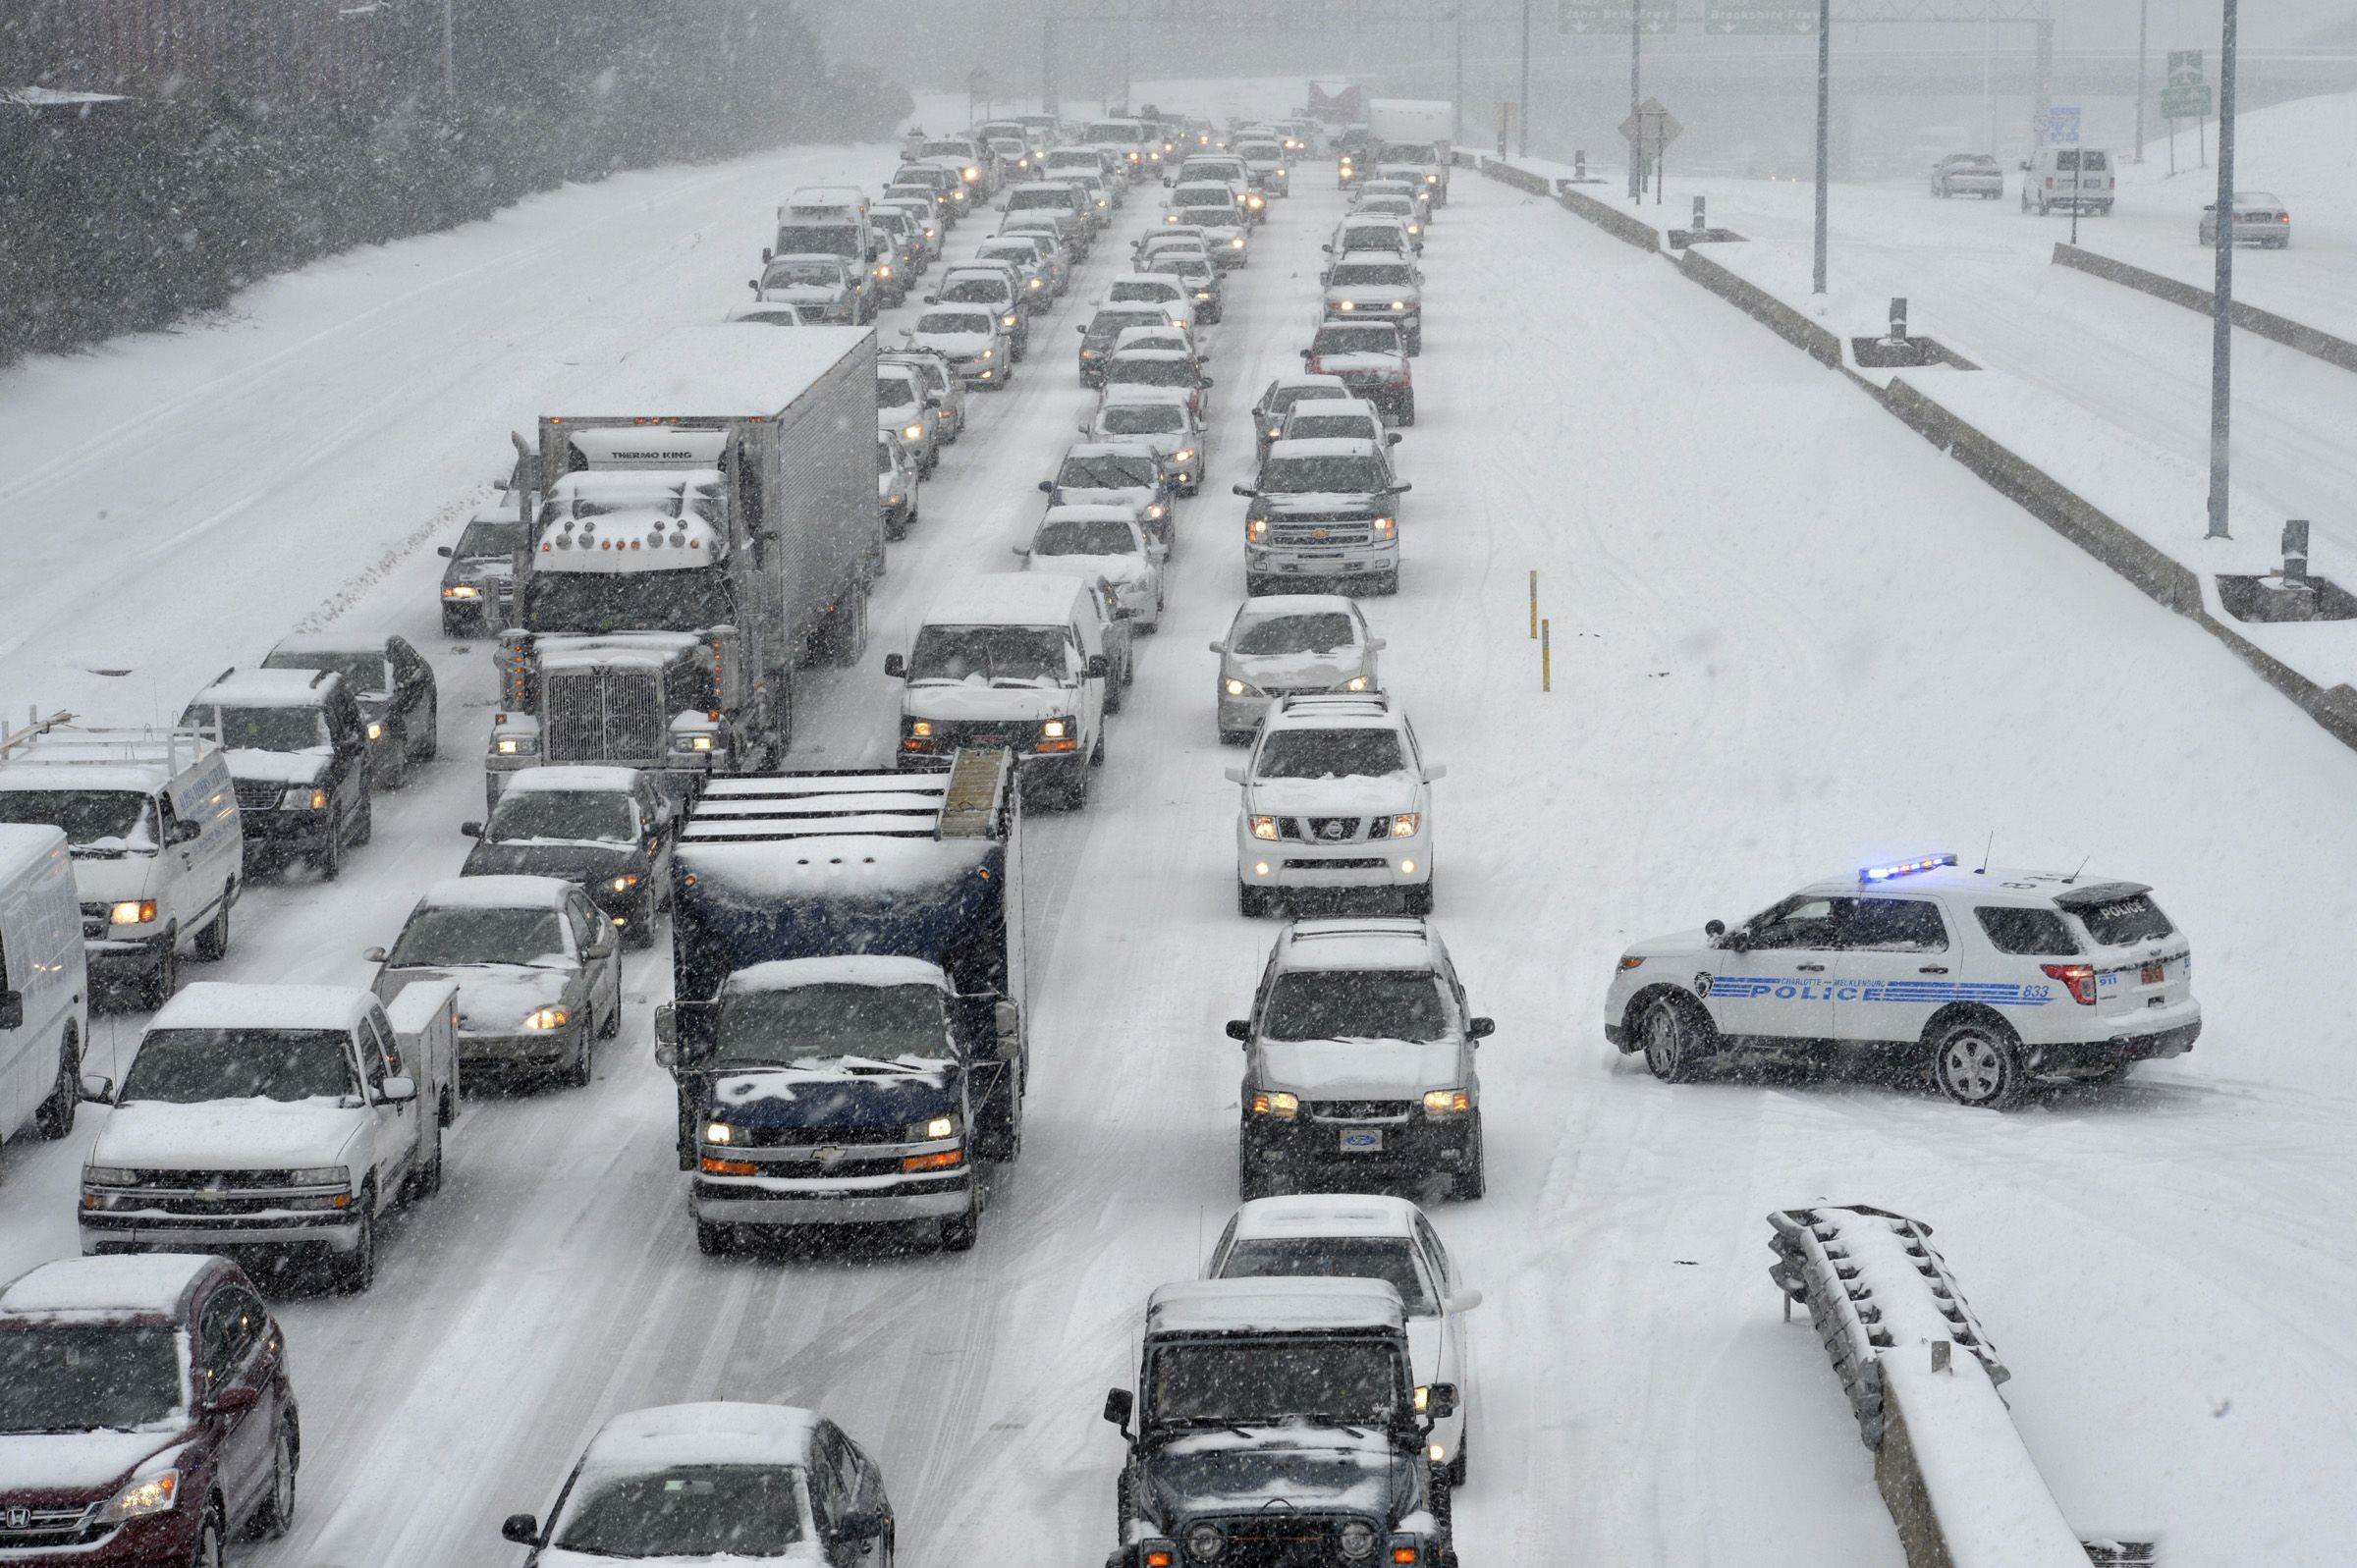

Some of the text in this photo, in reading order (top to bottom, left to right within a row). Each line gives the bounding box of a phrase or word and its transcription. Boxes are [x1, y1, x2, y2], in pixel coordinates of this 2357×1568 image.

[1711, 10, 1819, 20] Brookshire Frwy
[2101, 902, 2146, 920] POLICE
[1750, 986, 1884, 1000] POLICE
[2023, 985, 2050, 997] 833
